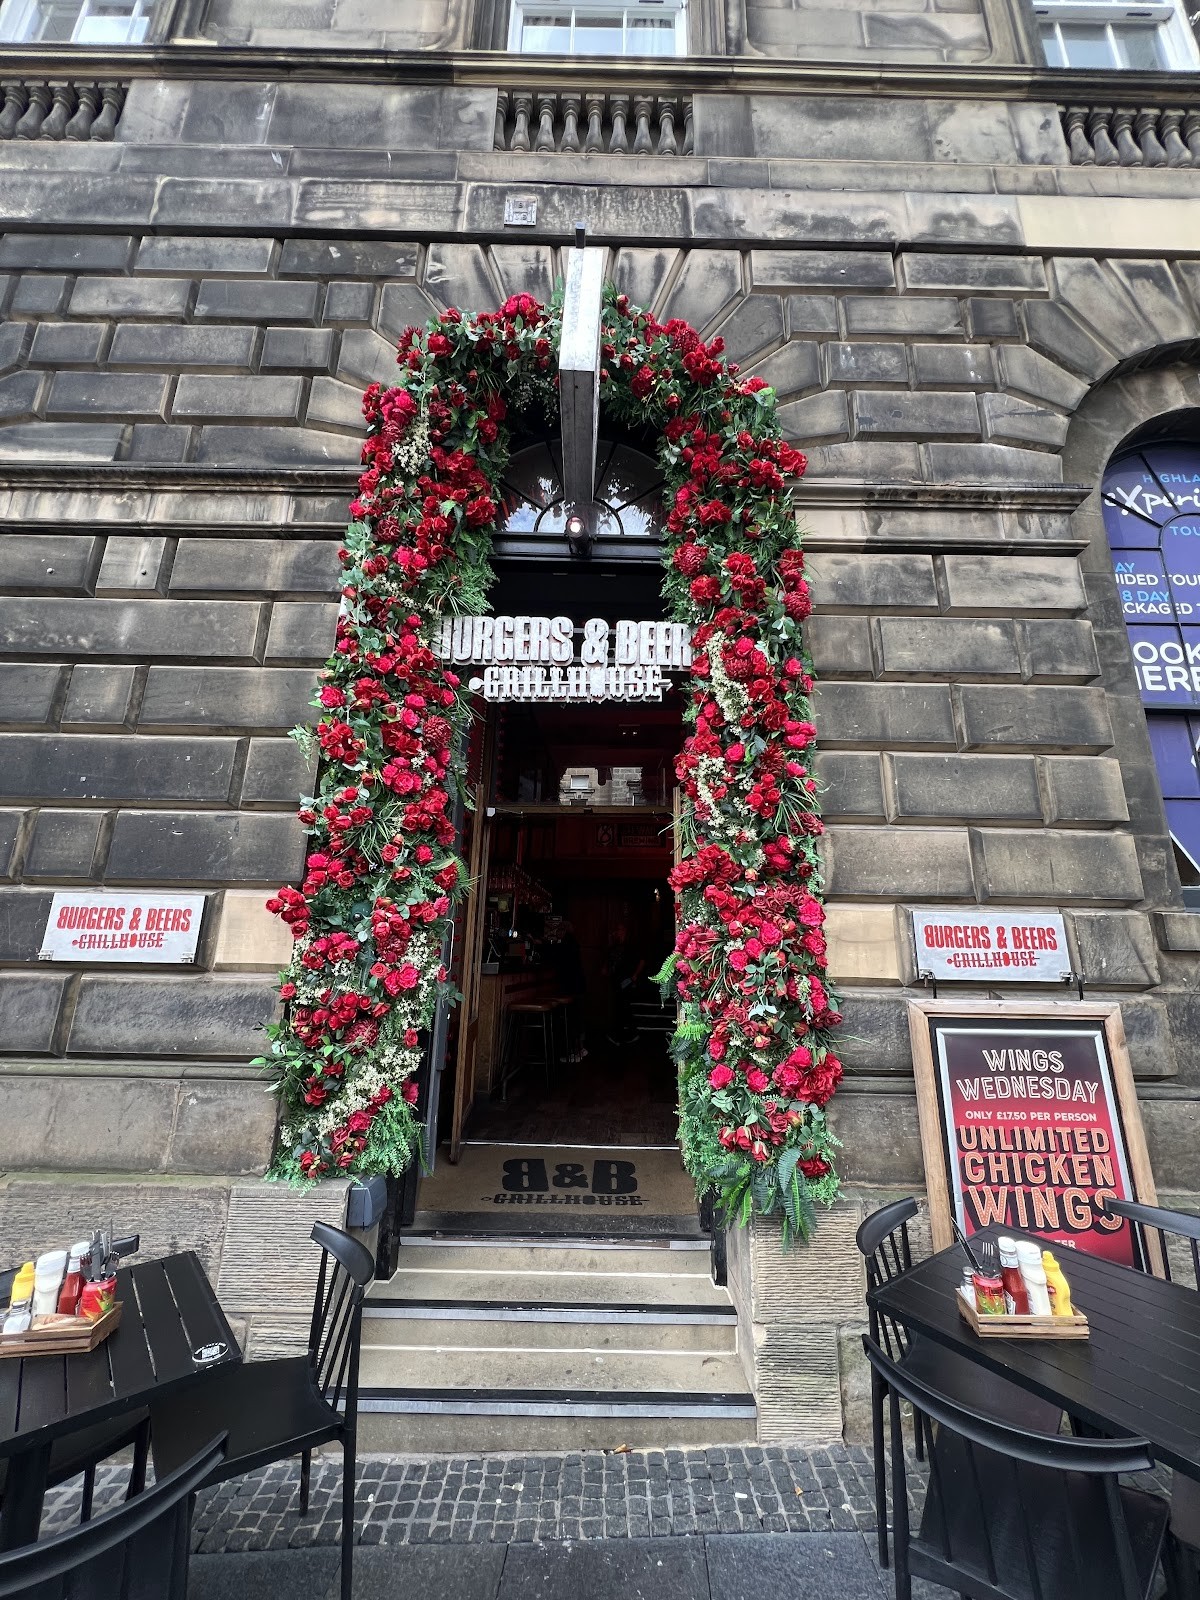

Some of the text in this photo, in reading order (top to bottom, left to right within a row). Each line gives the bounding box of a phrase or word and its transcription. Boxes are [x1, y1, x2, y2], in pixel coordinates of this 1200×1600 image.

[1142, 473, 1200, 483] HGHLA
[1122, 590, 1169, 602] 8 DAY
[1122, 602, 1193, 614] CKAGED
[582, 618, 609, 667] &
[484, 666, 662, 701] GRILLHOUSE
[57, 906, 192, 932] BURGERS & BEERS
[79, 933, 165, 949] GRILLHOUSE
[924, 925, 1058, 950] BURGERS & BEERS
[953, 951, 1037, 968] GRILLHOUSE
[982, 1049, 1065, 1073] WINGS
[956, 1075, 1099, 1104] WEDNESDAY
[965, 1110, 1097, 1122] ONLY £17.50 PER PERSON
[959, 1125, 1110, 1153] UNLIMITED
[964, 1152, 1116, 1186] CHICKEN
[493, 1193, 643, 1206] GRILLHOUSE
[968, 1186, 1123, 1230] WINGS
